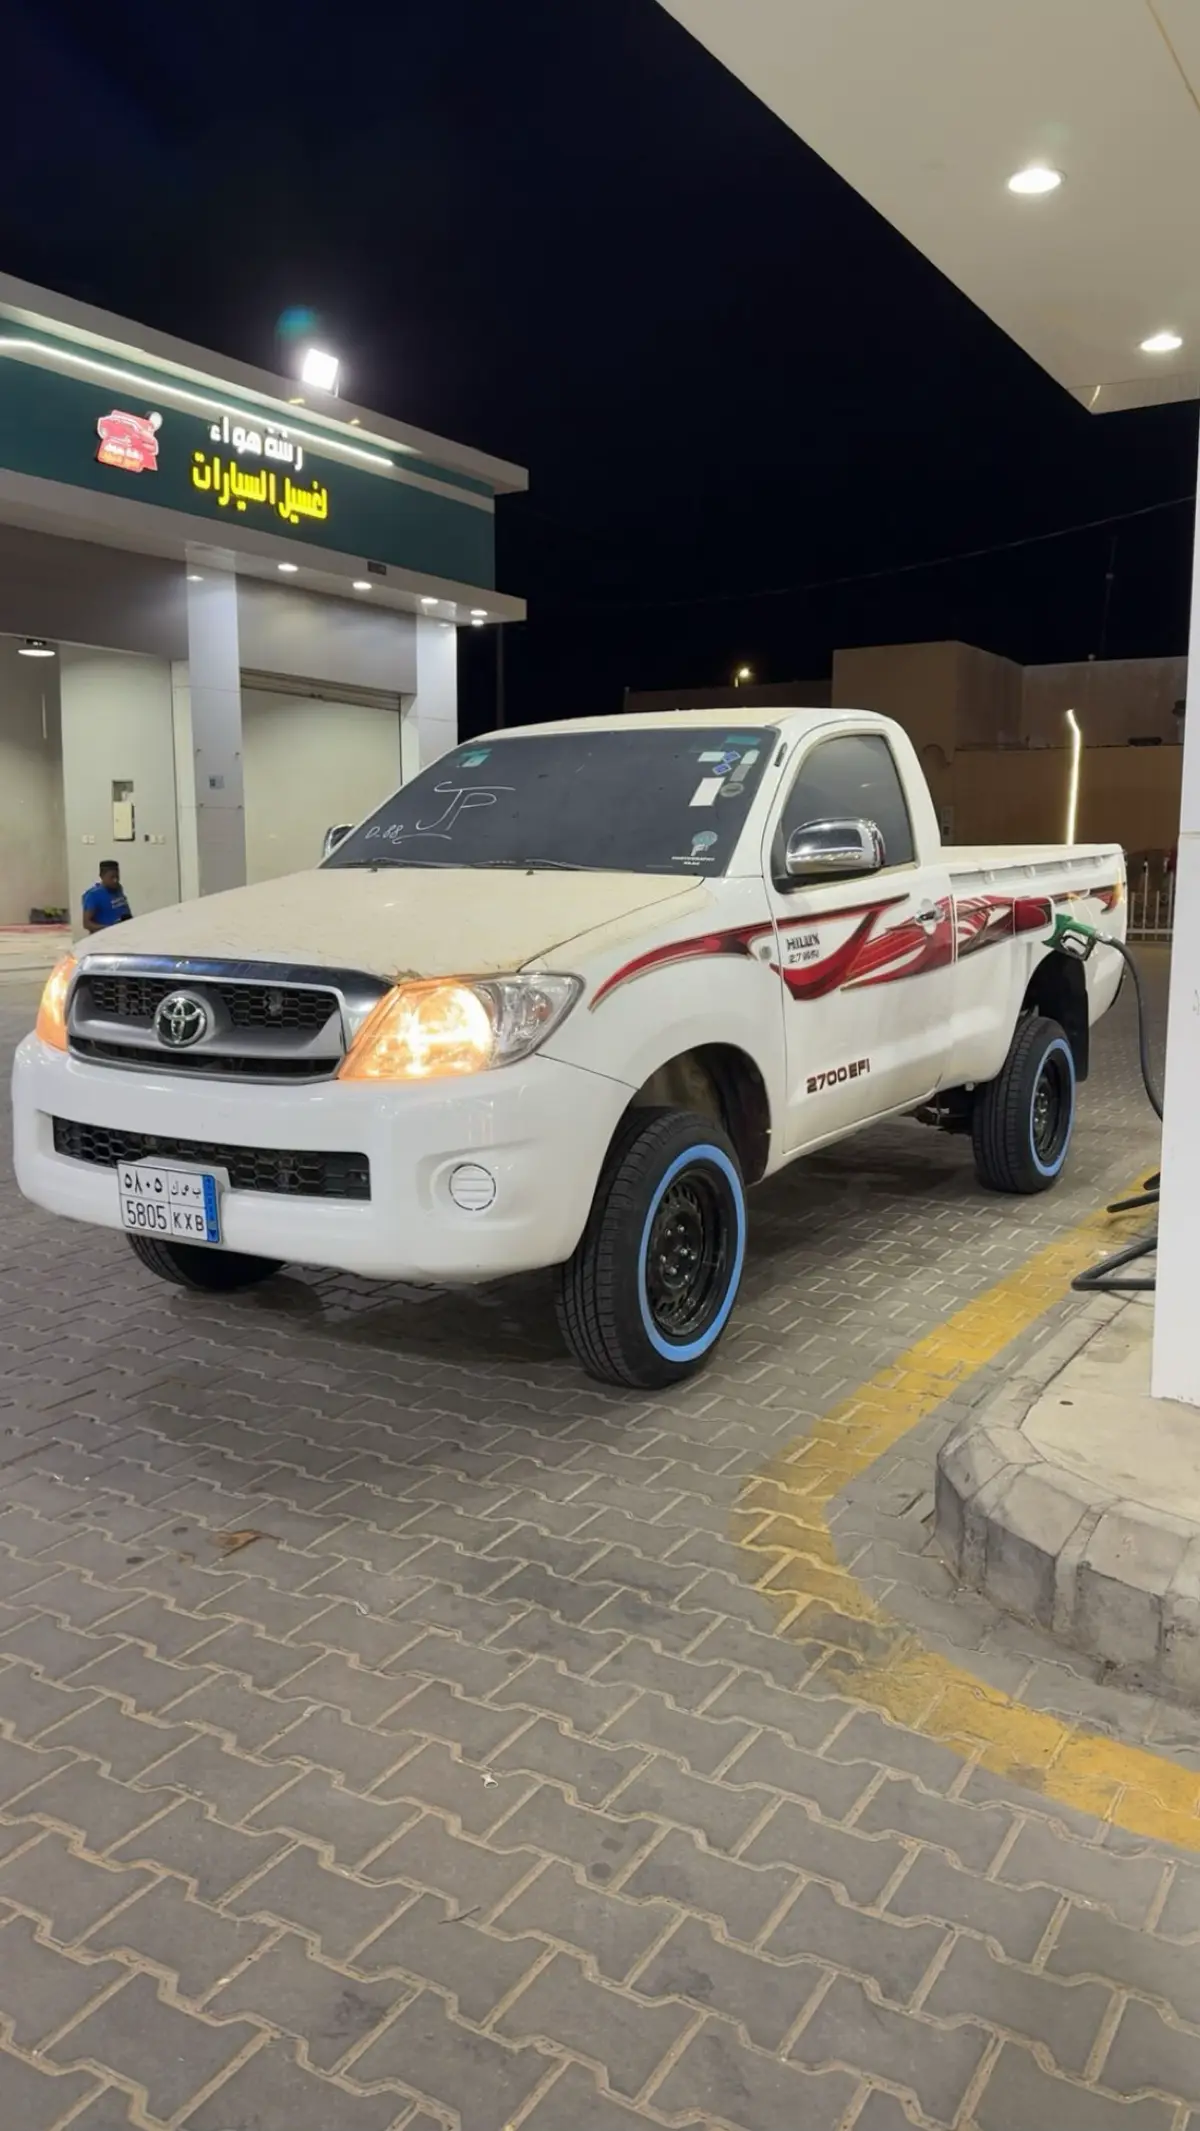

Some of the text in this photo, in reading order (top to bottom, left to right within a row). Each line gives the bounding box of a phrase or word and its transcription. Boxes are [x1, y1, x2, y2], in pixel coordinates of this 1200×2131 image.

[209, 416, 303, 471] رشة هواء
[193, 452, 276, 511] السيارات
[279, 477, 327, 523] لغسيل
[786, 932, 820, 951] HILUX
[126, 1200, 167, 1230] 5805
